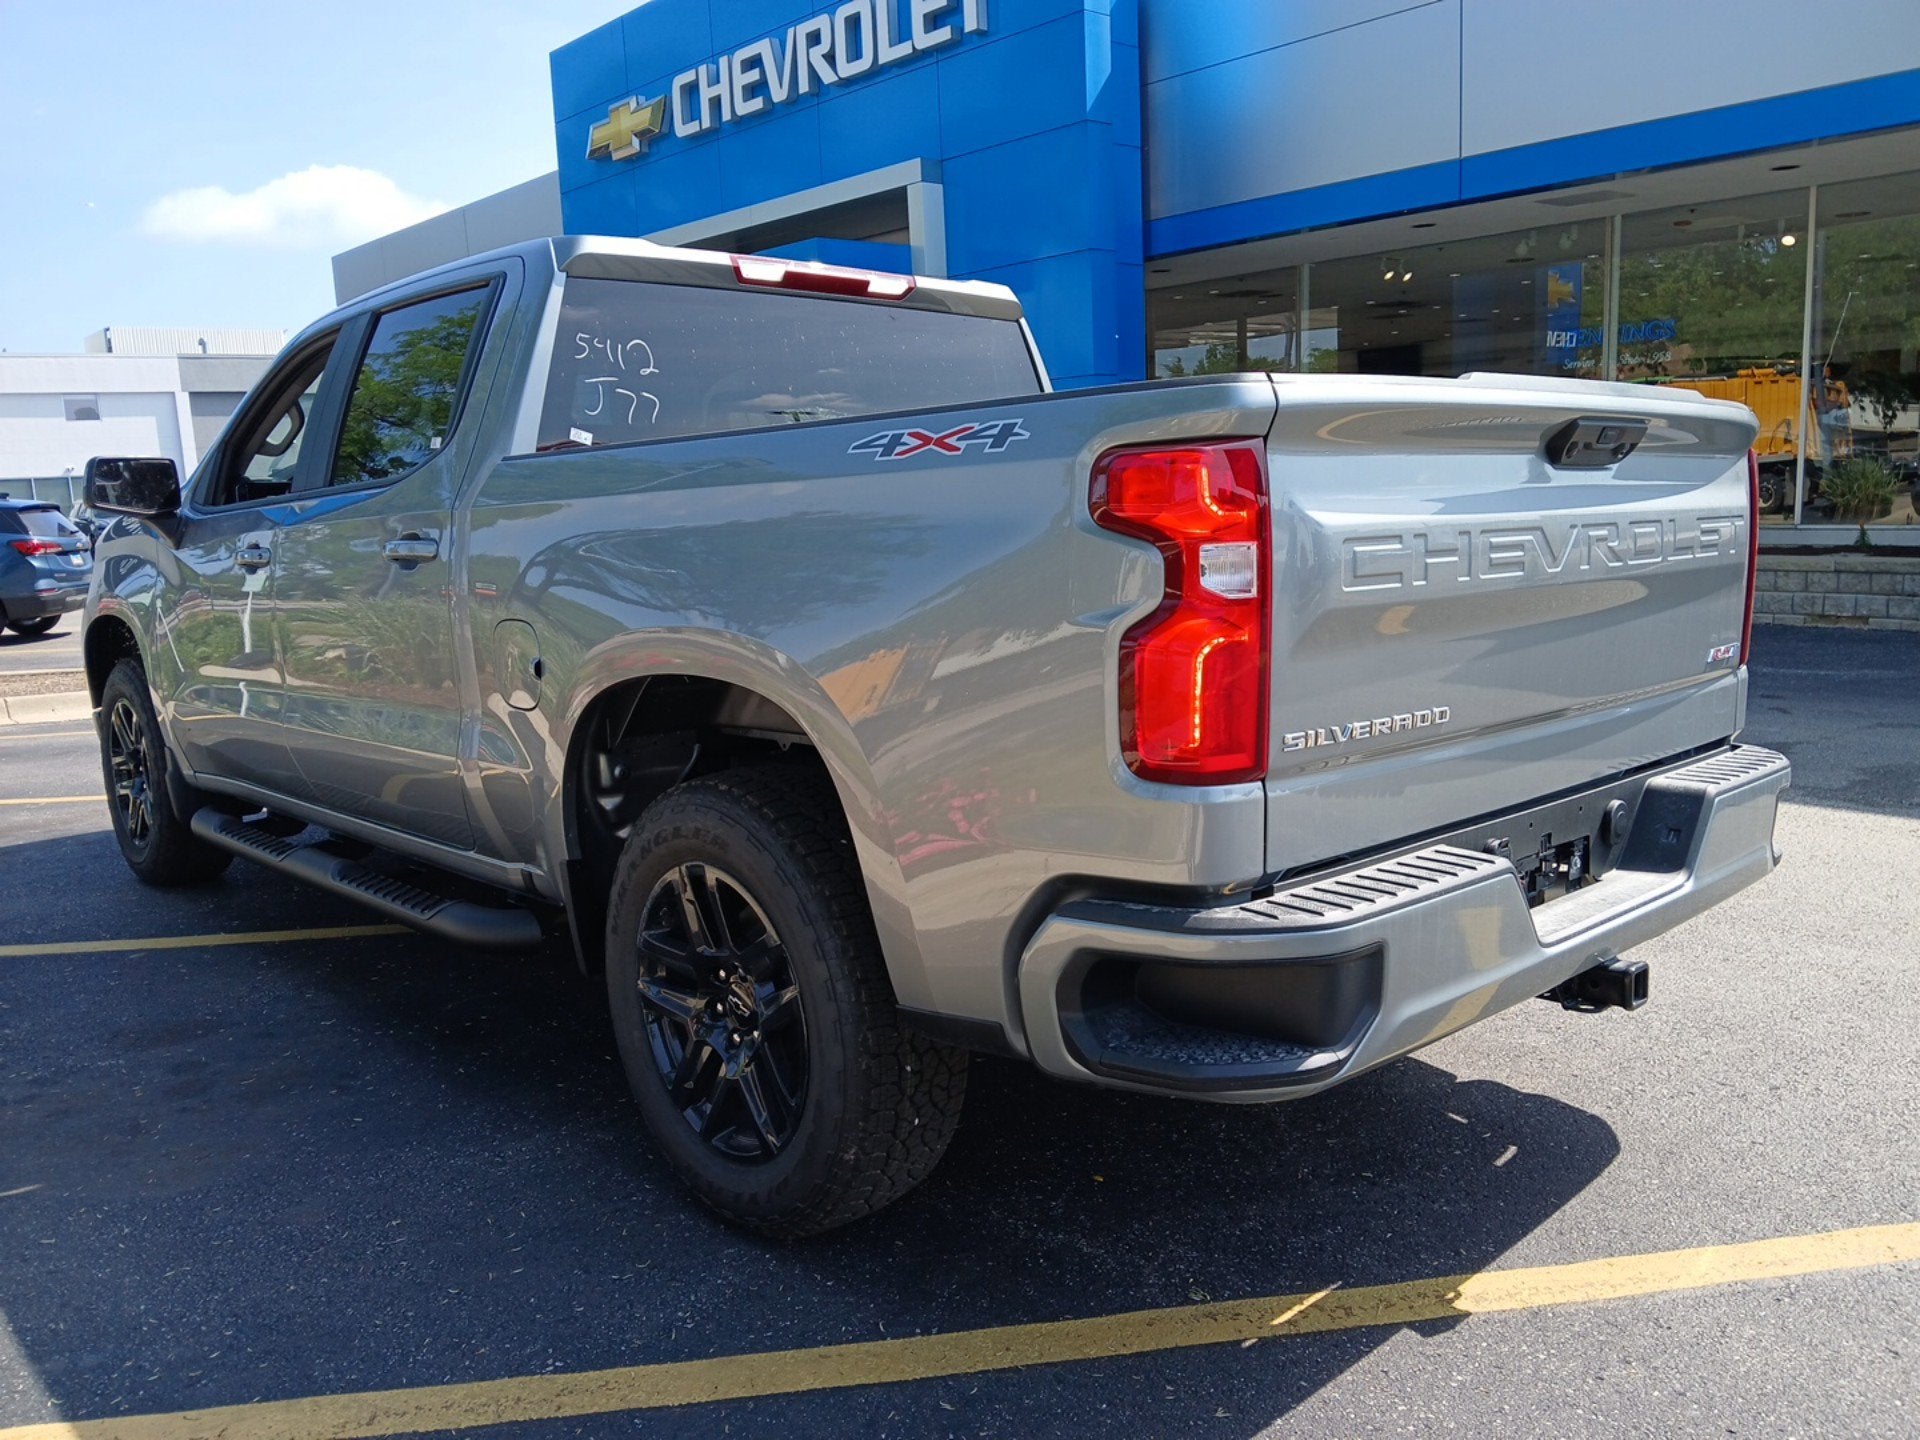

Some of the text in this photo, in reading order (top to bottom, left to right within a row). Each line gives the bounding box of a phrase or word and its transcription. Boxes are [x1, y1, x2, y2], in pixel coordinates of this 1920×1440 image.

[584, 376, 660, 425] J77
[1341, 514, 1744, 592] CHEVROLET
[1283, 706, 1451, 752] SILVERADO
